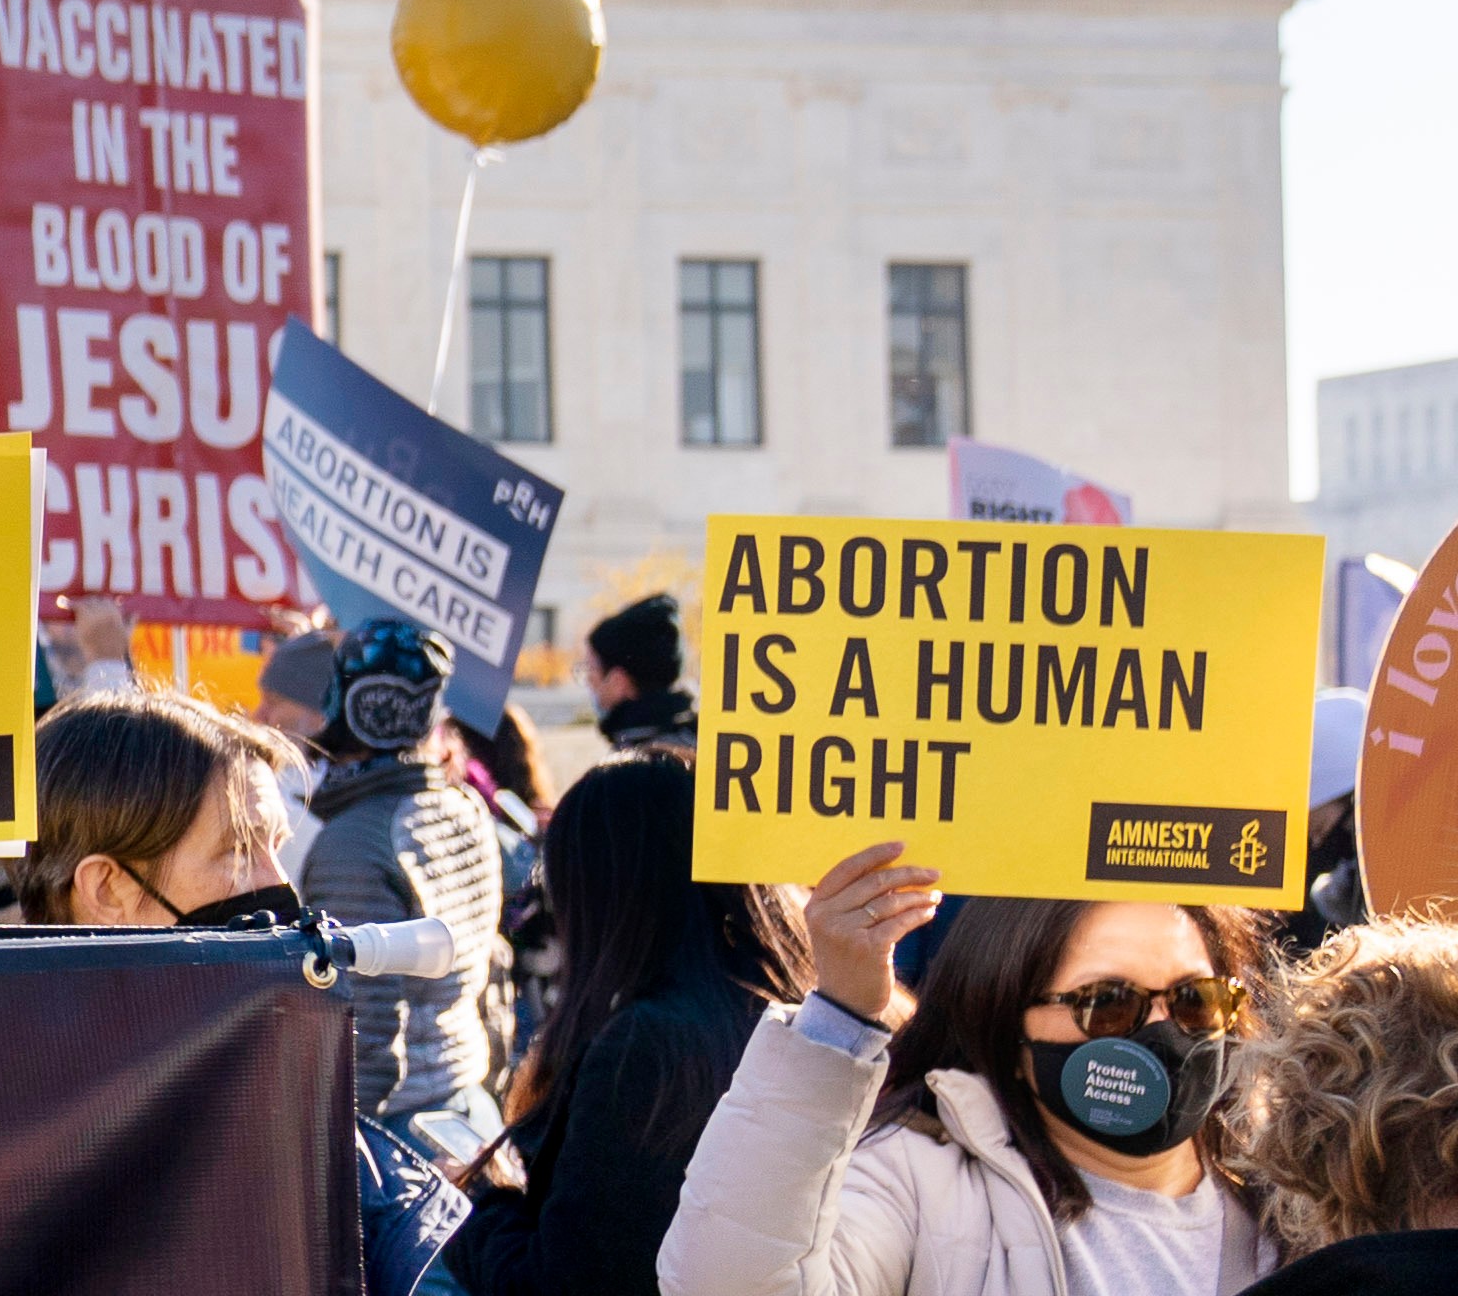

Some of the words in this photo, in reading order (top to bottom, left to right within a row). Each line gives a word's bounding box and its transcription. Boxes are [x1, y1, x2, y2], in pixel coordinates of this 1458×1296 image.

[72, 99, 130, 188] IN
[139, 110, 243, 198] THE
[32, 202, 208, 301] BLOOD
[223, 221, 292, 306] OF
[8, 305, 284, 451] JESU
[37, 461, 316, 607] CHRIS
[276, 415, 447, 554] ABORTION
[454, 534, 494, 582] IS
[272, 466, 382, 581] HEALTH
[392, 565, 496, 650] CARE
[717, 533, 1150, 629] ABORTION
[720, 631, 797, 715] IS
[829, 637, 880, 719] A
[915, 640, 1208, 732] HUMAN
[1386, 585, 1458, 705] lov
[712, 731, 972, 823] RIGHT
[1369, 725, 1424, 757] i
[1105, 848, 1212, 872] INTERNATIONAL
[1106, 817, 1214, 851] AMNESTY
[1084, 1086, 1131, 1106] Access
[1085, 1073, 1146, 1096] Abortion
[1087, 1059, 1137, 1082] Protect
